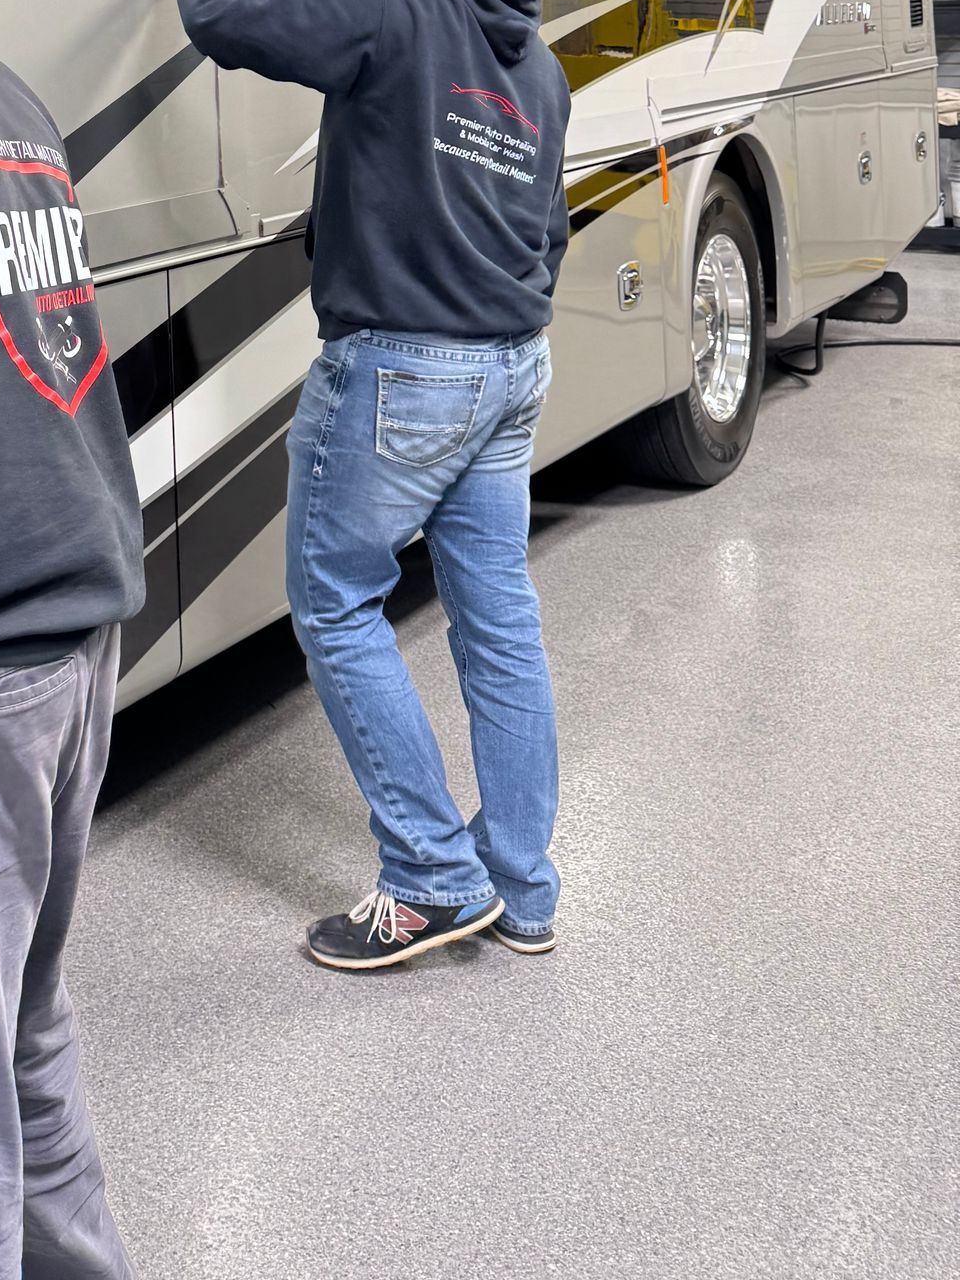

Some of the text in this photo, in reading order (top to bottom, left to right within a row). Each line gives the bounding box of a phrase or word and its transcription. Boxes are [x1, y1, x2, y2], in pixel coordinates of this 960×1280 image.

[446, 112, 537, 156] Premier Auto Detailing
[459, 129, 466, 139] &
[489, 141, 502, 154] Car
[503, 147, 525, 162] Wash
